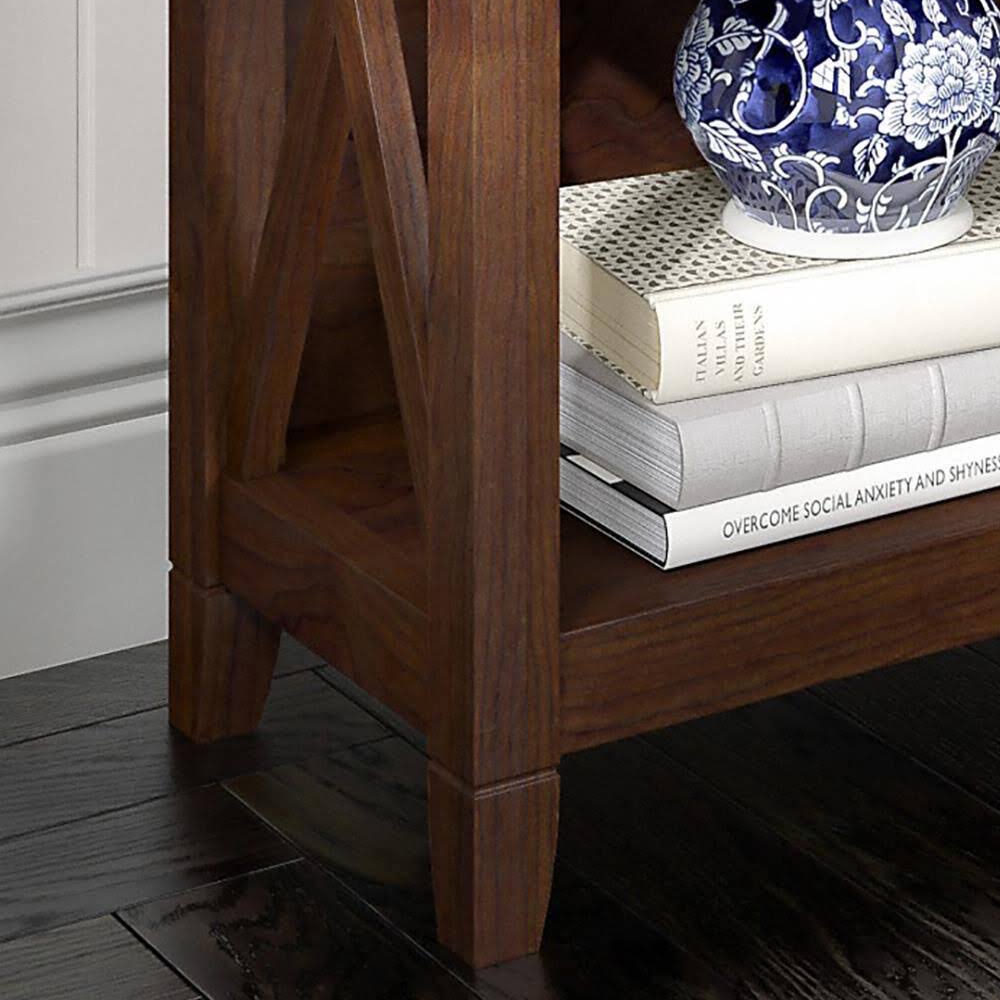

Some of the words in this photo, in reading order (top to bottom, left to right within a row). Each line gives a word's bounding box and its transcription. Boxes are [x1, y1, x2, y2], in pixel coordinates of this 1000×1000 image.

[695, 319, 708, 383] ITALIAN
[714, 319, 727, 376] VILLAS
[732, 302, 746, 352] THEIR
[752, 304, 766, 377] GARDENS
[733, 355, 746, 383] AND
[721, 502, 801, 539] OVERCOME
[803, 491, 853, 521] SOCIAL
[854, 474, 912, 508] ANXIETY
[914, 467, 947, 491] AND
